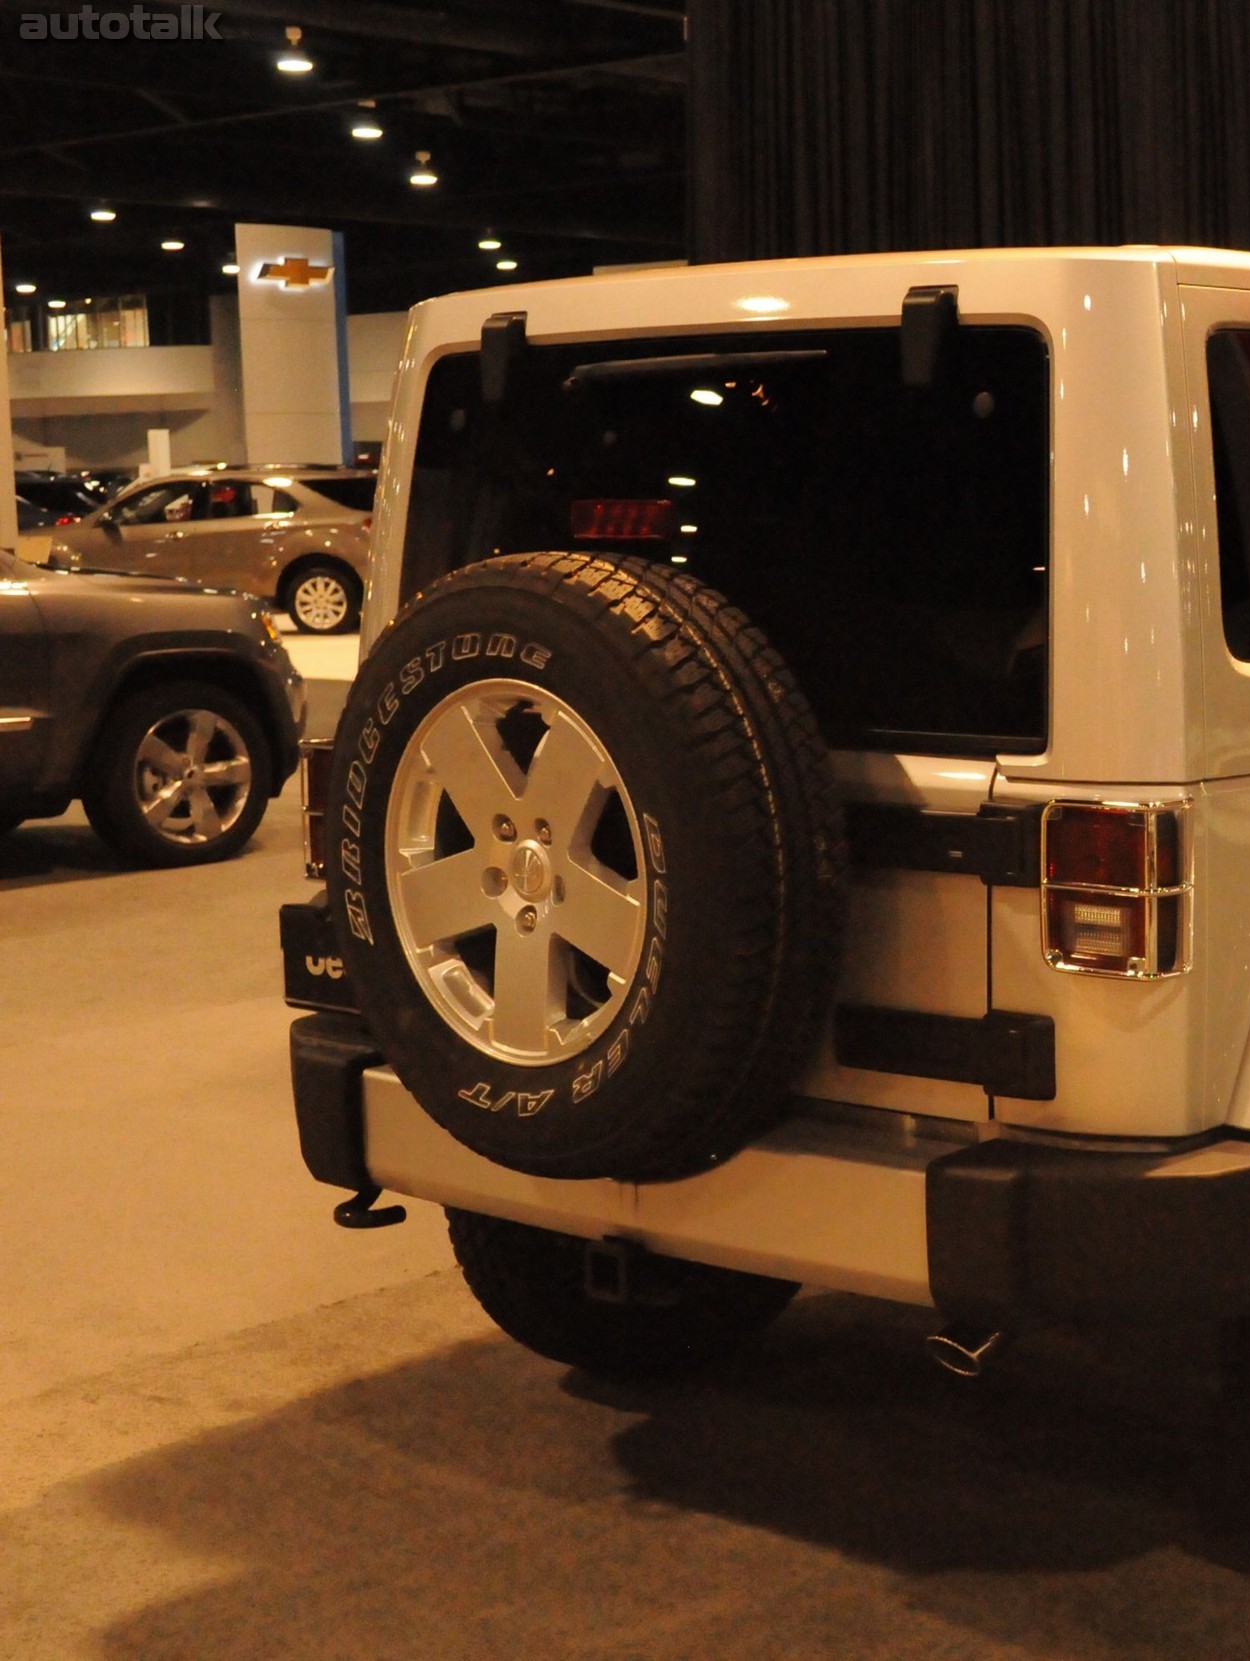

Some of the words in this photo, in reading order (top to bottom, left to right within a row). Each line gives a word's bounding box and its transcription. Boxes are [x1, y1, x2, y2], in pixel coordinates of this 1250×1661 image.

[342, 633, 552, 946] BRIDGESTONE
[458, 1083, 554, 1117] A/T
[572, 812, 667, 1104] DUELER
